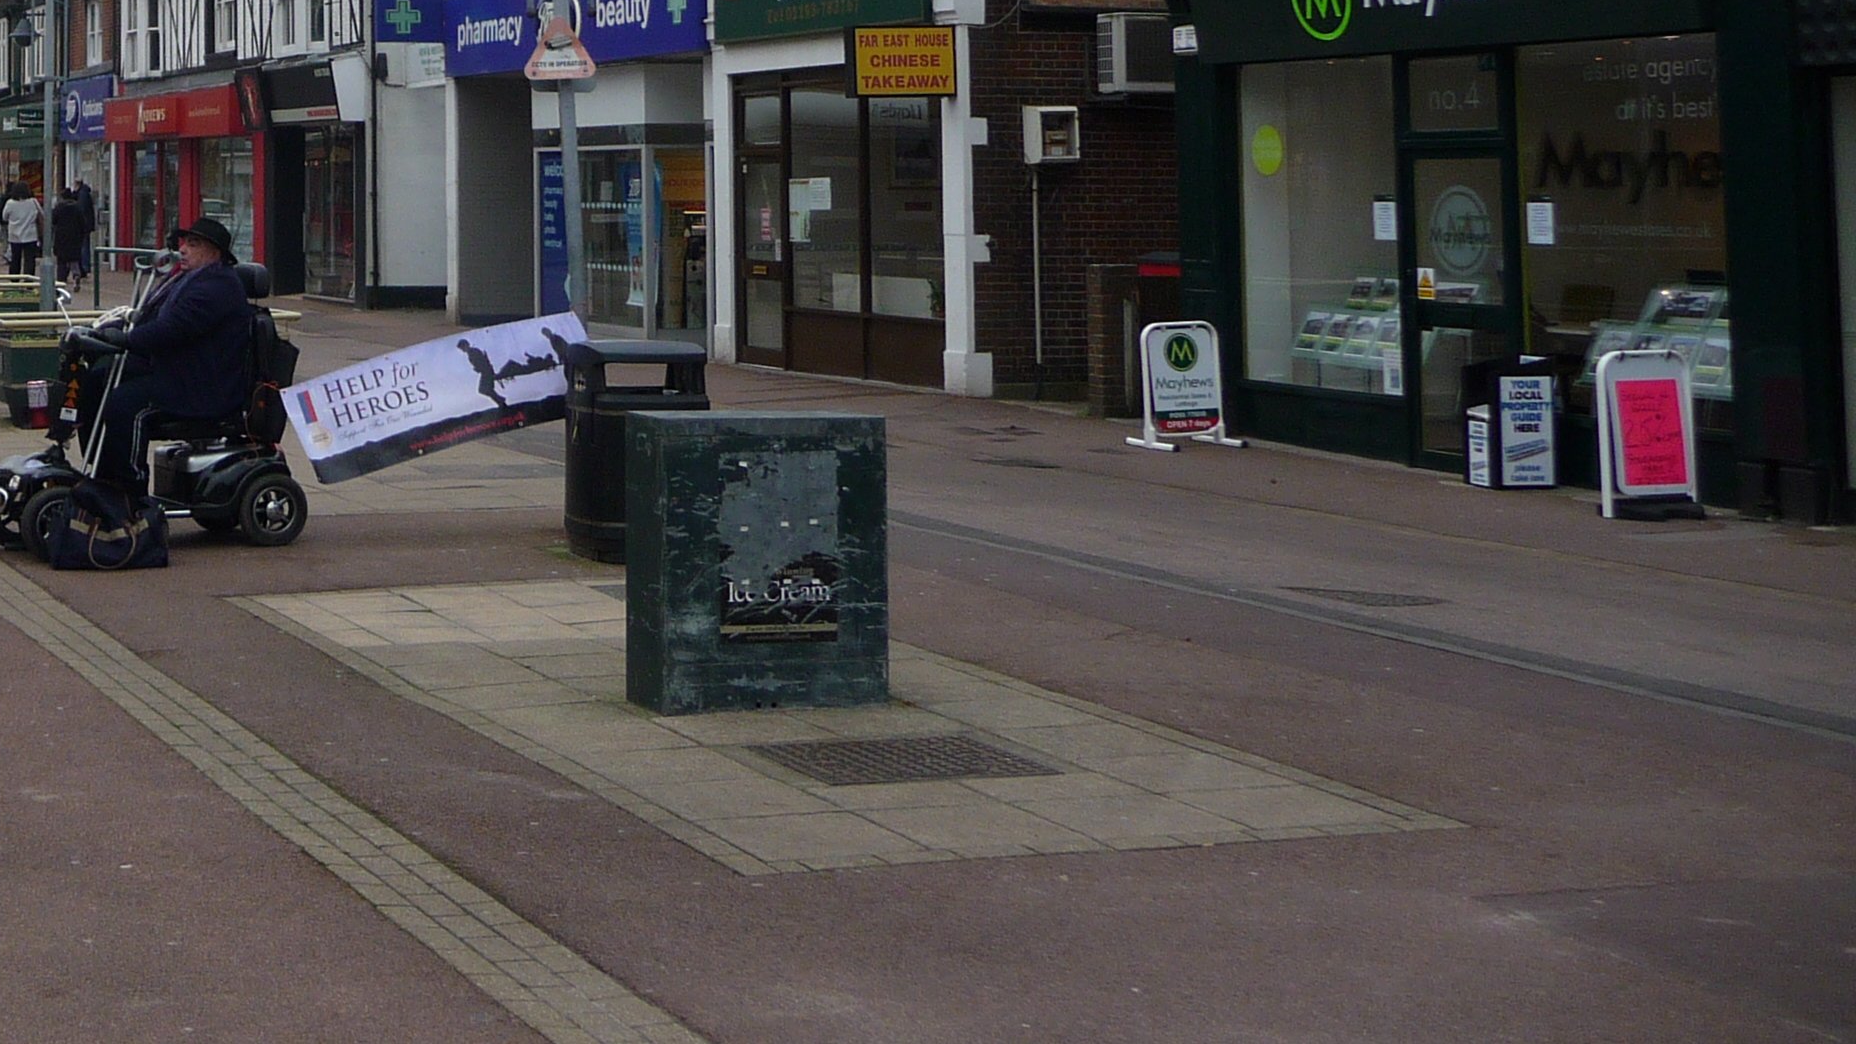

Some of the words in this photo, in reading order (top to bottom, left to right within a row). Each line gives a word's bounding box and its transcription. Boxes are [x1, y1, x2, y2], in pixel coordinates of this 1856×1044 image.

[457, 15, 523, 52] pharmacy
[859, 35, 879, 48] FAR
[883, 34, 910, 47] EAST
[915, 34, 949, 47] HOUSE
[870, 54, 941, 68] CHINESE
[1645, 57, 1717, 84] agency
[861, 75, 949, 89] TAKEAWAY
[1672, 91, 1713, 119] best
[1171, 340, 1193, 362] M
[322, 367, 385, 404] HELP
[391, 360, 420, 388] for
[1155, 374, 1214, 392] Mayhews
[1511, 380, 1540, 389] YOUR
[1509, 391, 1543, 400] LOCAL
[330, 380, 430, 428] HEROES
[1501, 402, 1550, 411] PROPERTY
[1166, 420, 1187, 429] OPEN
[1511, 413, 1542, 422] GUIDE
[1514, 423, 1541, 433] HERE
[728, 581, 755, 603] Ice
[763, 580, 831, 602] Cream
